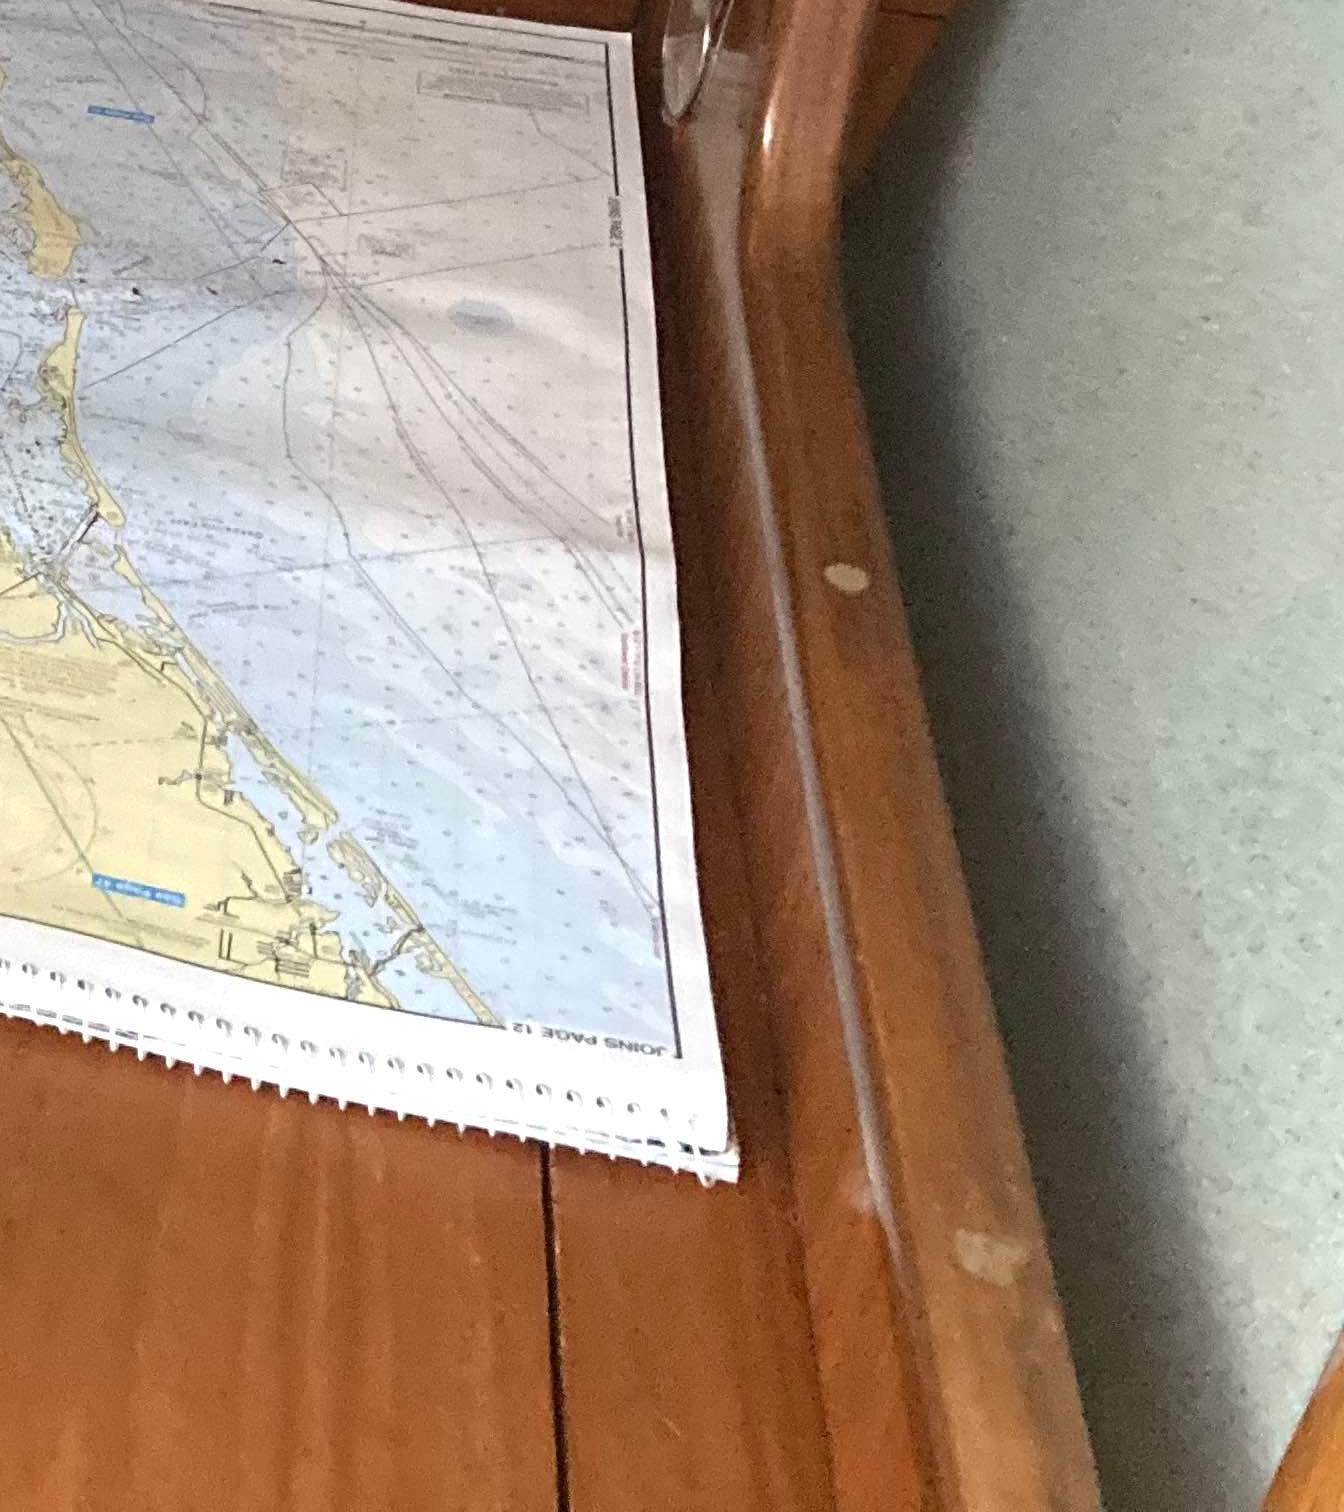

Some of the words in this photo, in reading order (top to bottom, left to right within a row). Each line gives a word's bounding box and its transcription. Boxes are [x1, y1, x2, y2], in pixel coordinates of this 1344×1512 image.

[511, 1022, 533, 1036] 12
[540, 1026, 598, 1047] PAGE
[603, 1037, 668, 1058] JOINS
